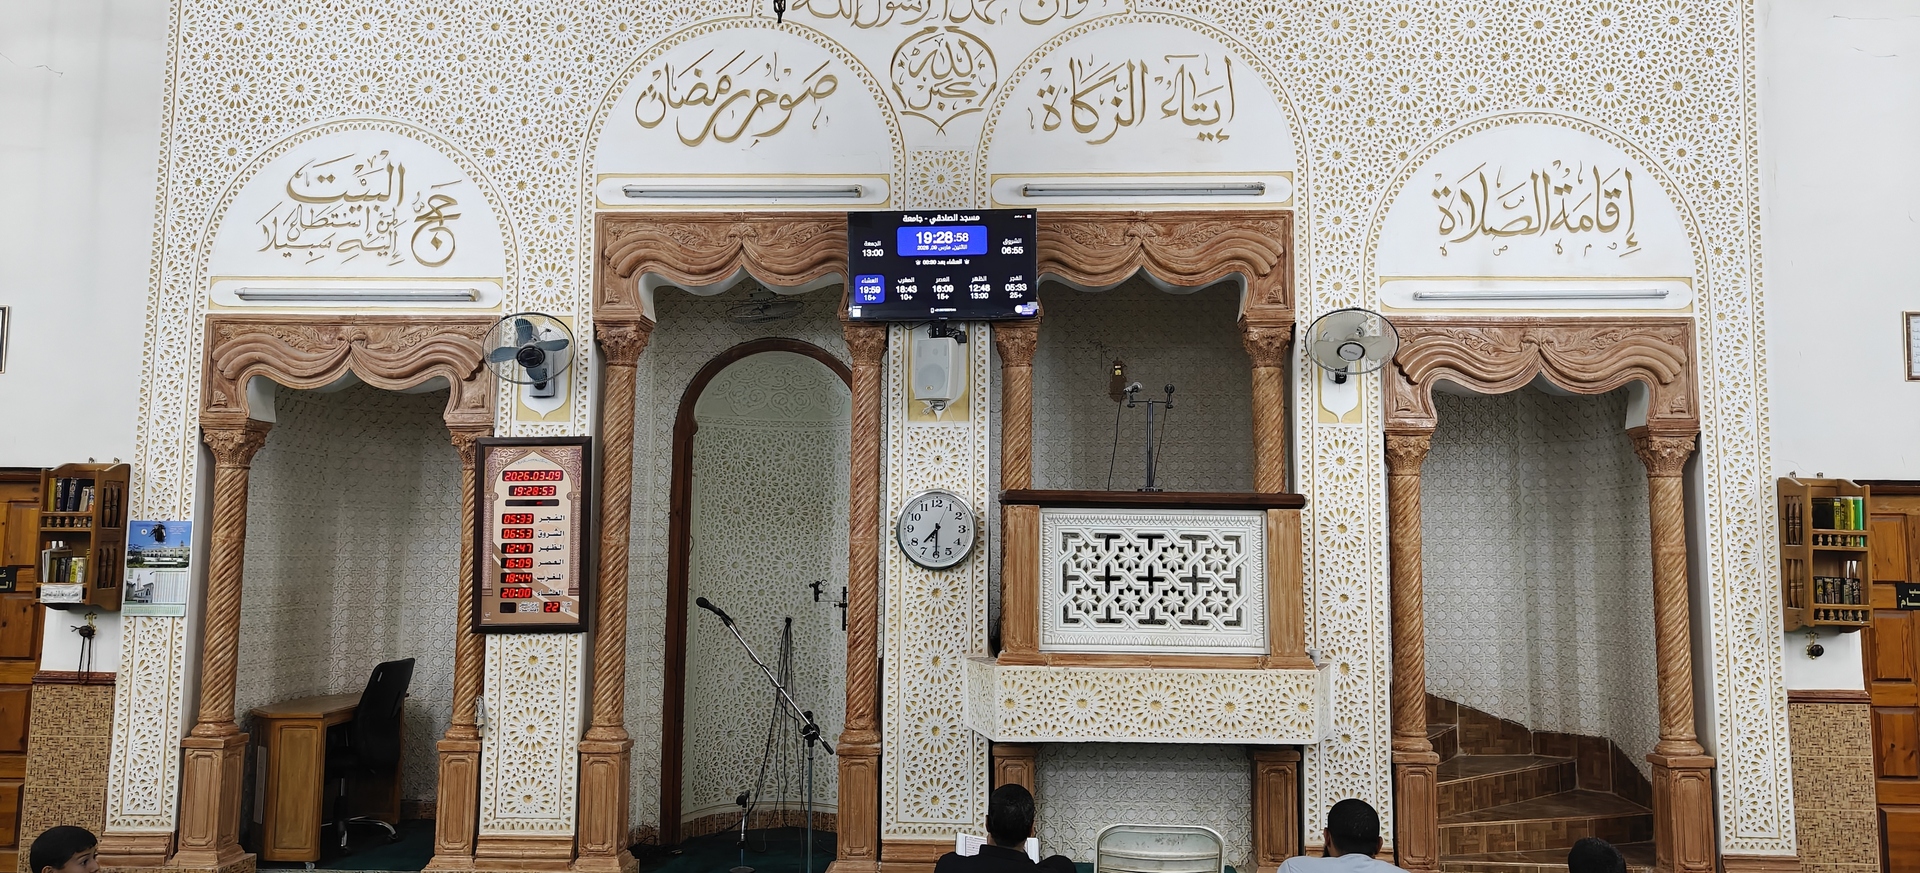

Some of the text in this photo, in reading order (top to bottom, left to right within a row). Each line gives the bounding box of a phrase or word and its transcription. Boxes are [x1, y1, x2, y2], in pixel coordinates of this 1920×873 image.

[635, 52, 838, 148] صوم رمضان
[286, 150, 405, 213] البيت
[1432, 164, 1550, 252] الصلاة
[960, 214, 981, 222] مسجد
[916, 231, 969, 244] 19:28:58
[504, 471, 561, 480] 2026.03.09
[513, 486, 555, 496] 19:28:53
[920, 503, 928, 511] 11
[931, 499, 943, 507] 12
[503, 514, 532, 524] 05:33
[911, 513, 921, 521] 10
[954, 511, 962, 520] 2
[503, 529, 532, 538] 06:53
[958, 525, 966, 533] 3
[910, 537, 918, 546] 8
[953, 537, 960, 545] 4
[505, 543, 532, 553] 12:47
[920, 547, 927, 555] 7
[944, 547, 952, 555] 5
[505, 558, 532, 568] 16:09
[505, 573, 532, 582] 18:44
[502, 588, 532, 598] 20:00
[545, 602, 559, 612] 22
